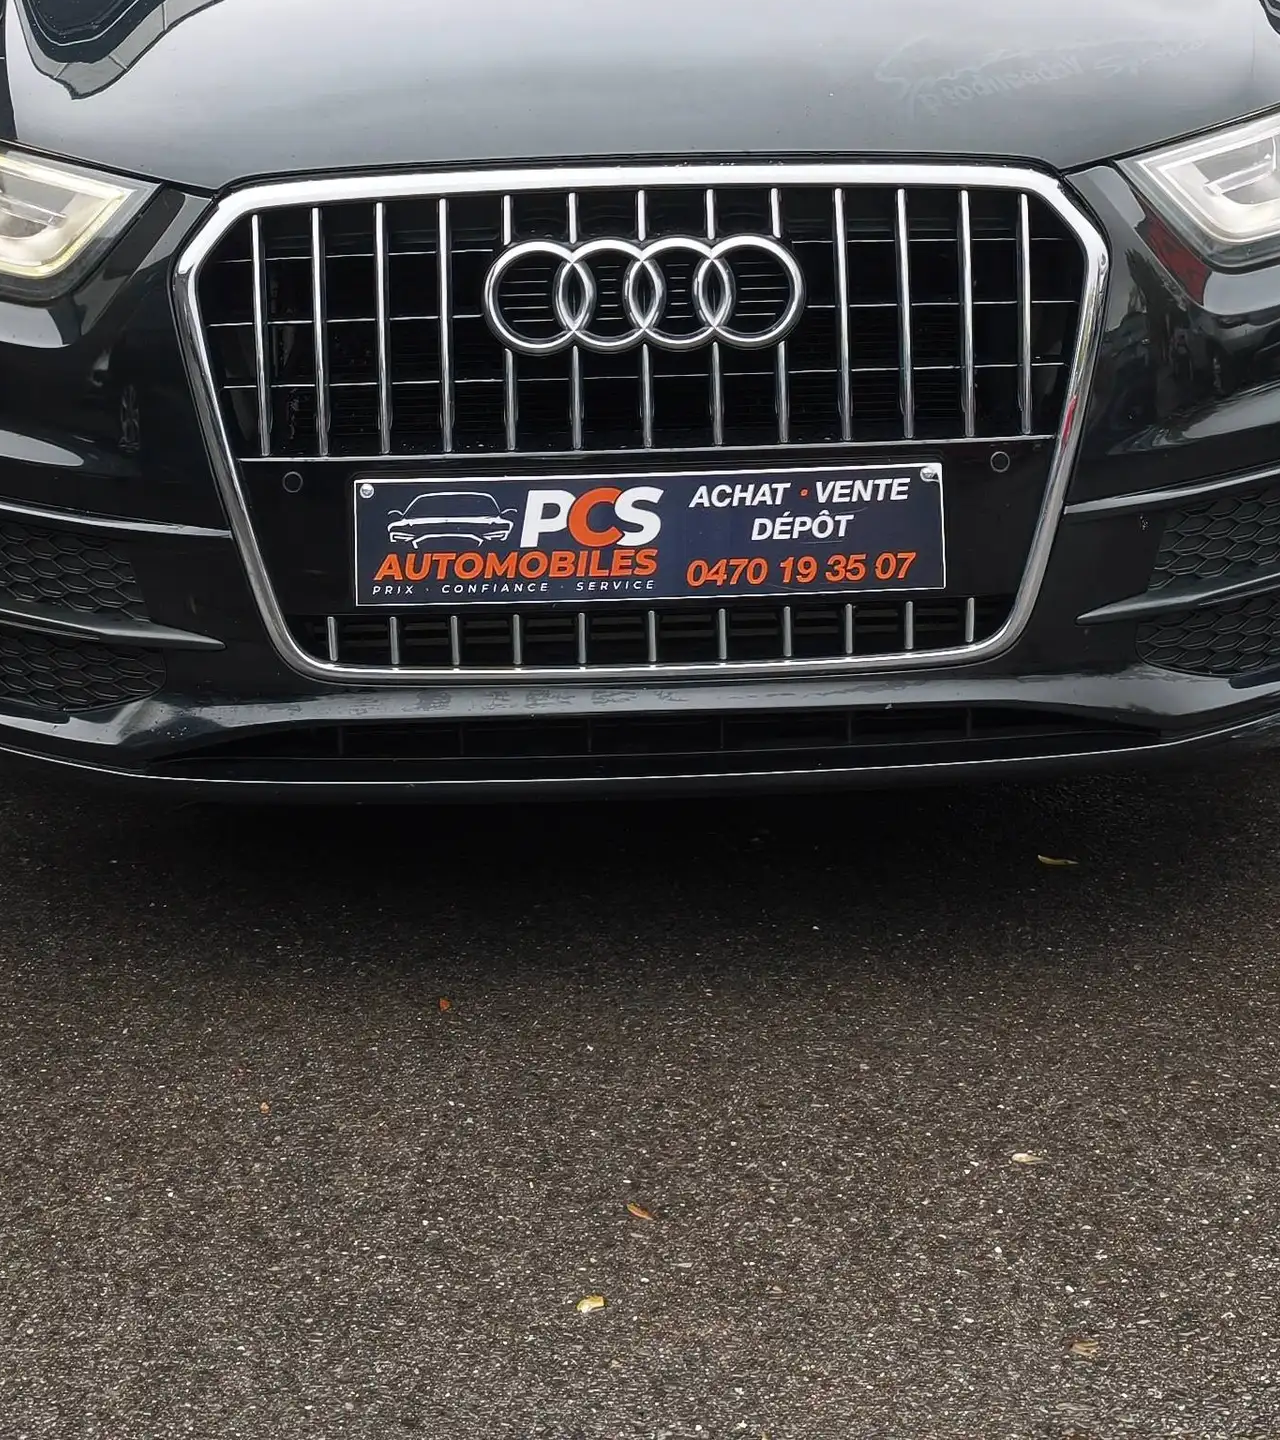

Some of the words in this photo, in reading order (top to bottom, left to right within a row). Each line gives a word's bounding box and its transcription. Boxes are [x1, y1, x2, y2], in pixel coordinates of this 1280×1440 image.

[689, 482, 791, 508] ACHAT
[815, 477, 911, 503] VENTE
[520, 486, 664, 548] PCS
[751, 510, 854, 541] DÉPÔT
[373, 548, 658, 581] AUTOMOBILES
[686, 558, 768, 587] 0470
[780, 556, 818, 584] 19
[825, 553, 867, 581] 35
[875, 551, 917, 580] 07
[372, 584, 414, 595] PRIX
[441, 582, 549, 594] CONFIANCE
[575, 580, 655, 592] SERVICE
